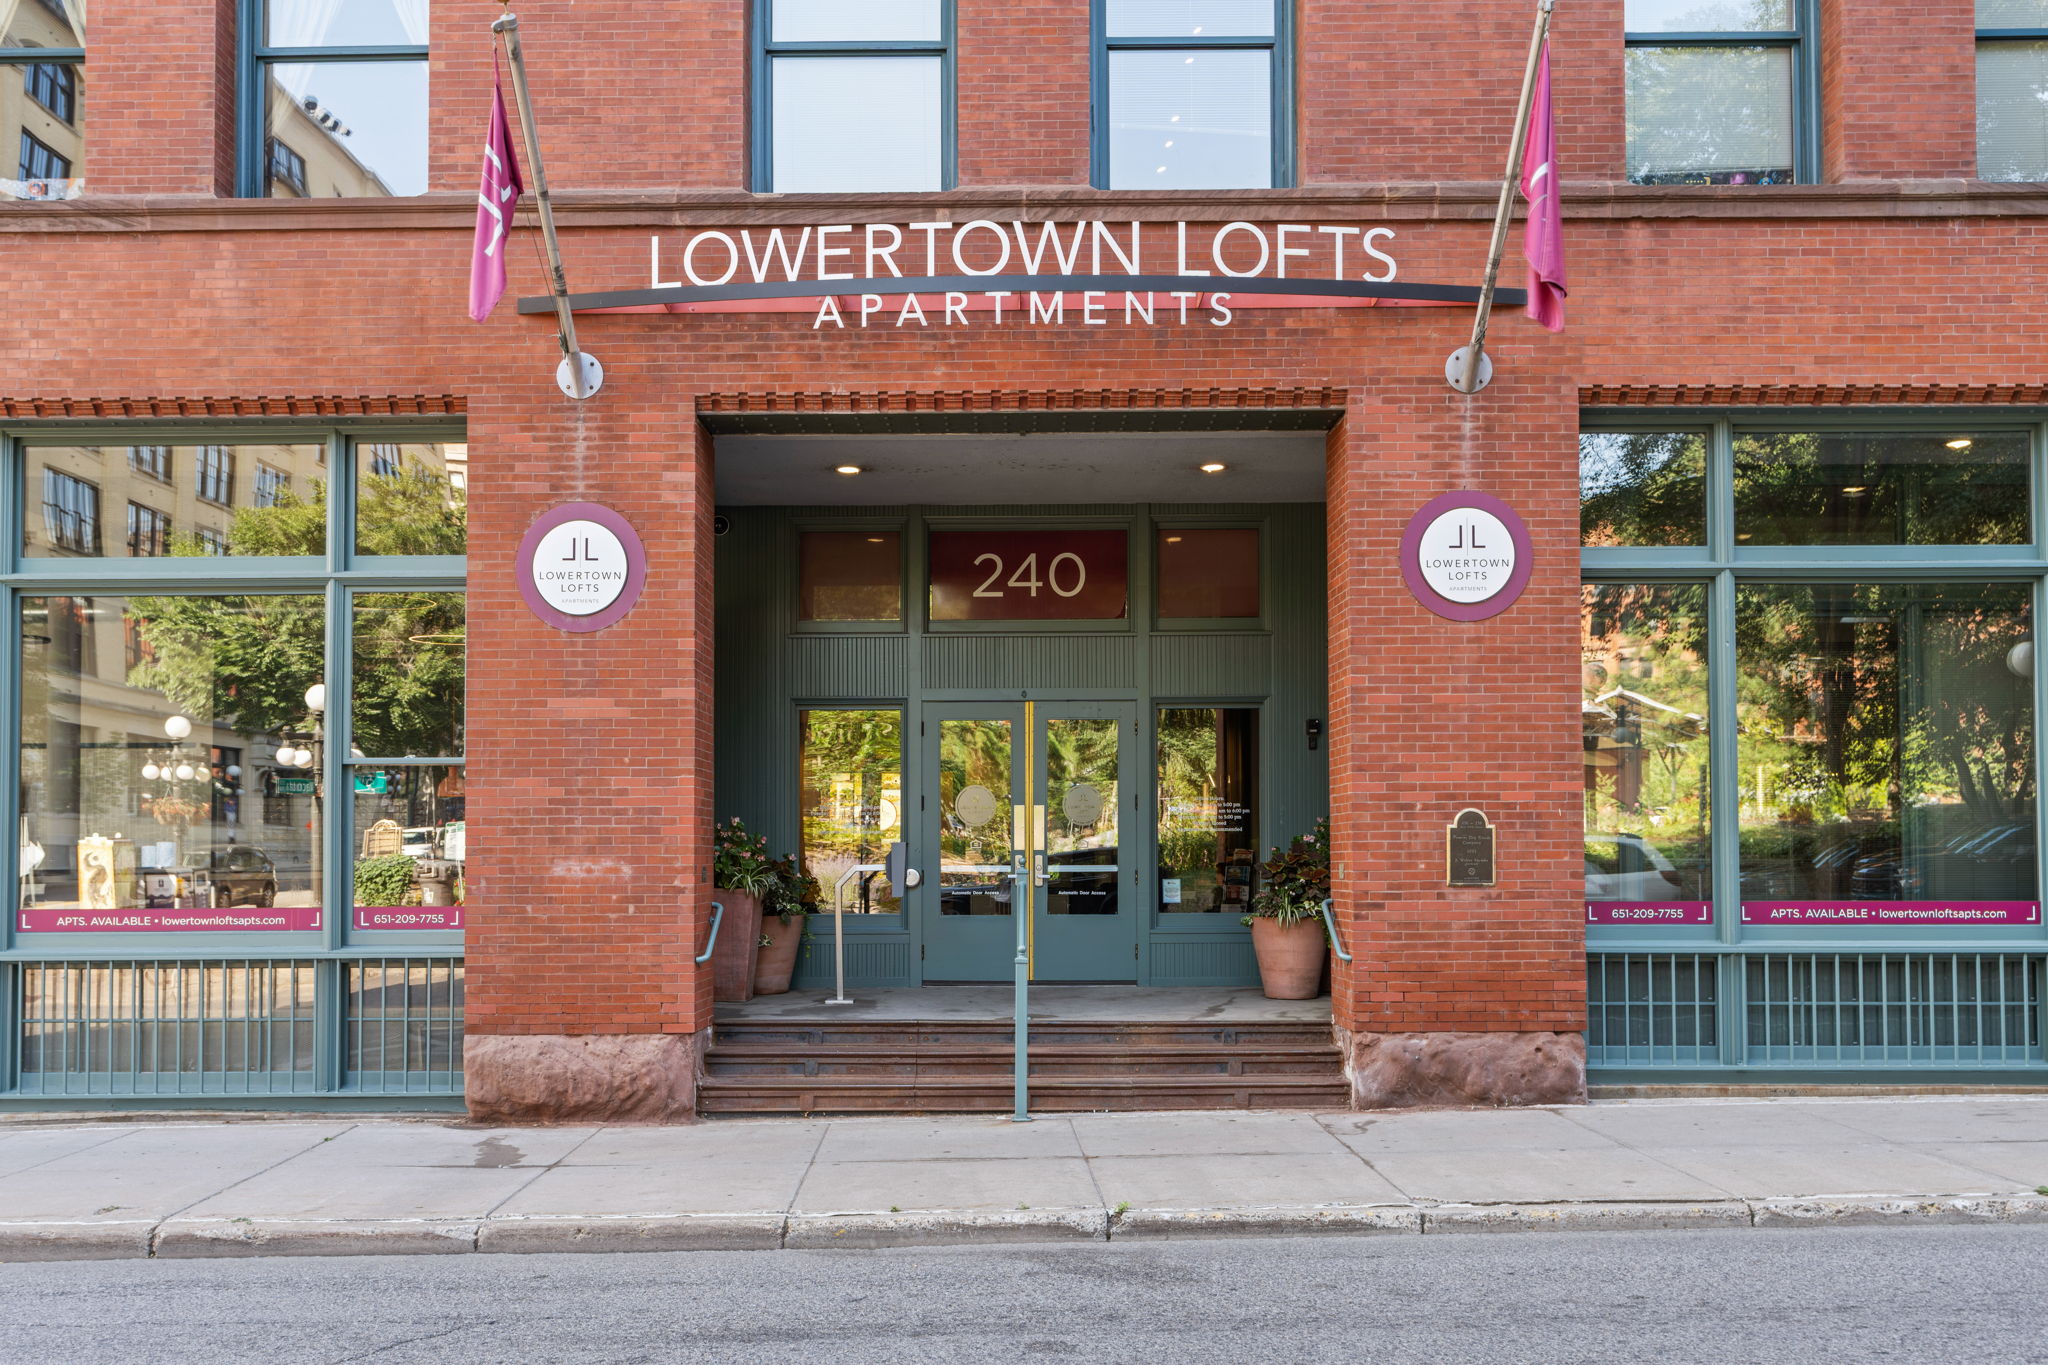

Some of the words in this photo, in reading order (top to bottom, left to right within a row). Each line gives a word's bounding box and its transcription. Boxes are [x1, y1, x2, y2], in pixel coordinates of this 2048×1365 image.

[651, 220, 1140, 289] LOWERTOWN
[1178, 221, 1397, 283] LOFTS
[813, 291, 1232, 329] APARTMENTS
[1426, 558, 1510, 568] LOWERTOWN
[539, 571, 622, 580] LOWERTOWN
[973, 552, 1086, 597] 240
[1448, 571, 1488, 581] LOFTS
[560, 583, 600, 592] LOFTS
[1611, 909, 1684, 919] 651-209-7755
[1770, 908, 1802, 919] APTS.
[1805, 908, 1868, 918] AVAILABLE
[1879, 908, 2007, 919] lowertownloftsapts.com
[56, 916, 88, 926] APTS.
[90, 916, 151, 926] AVAILABLE
[161, 916, 286, 927] lowertownloftsapts.com
[374, 914, 445, 924] 651-209-7755
